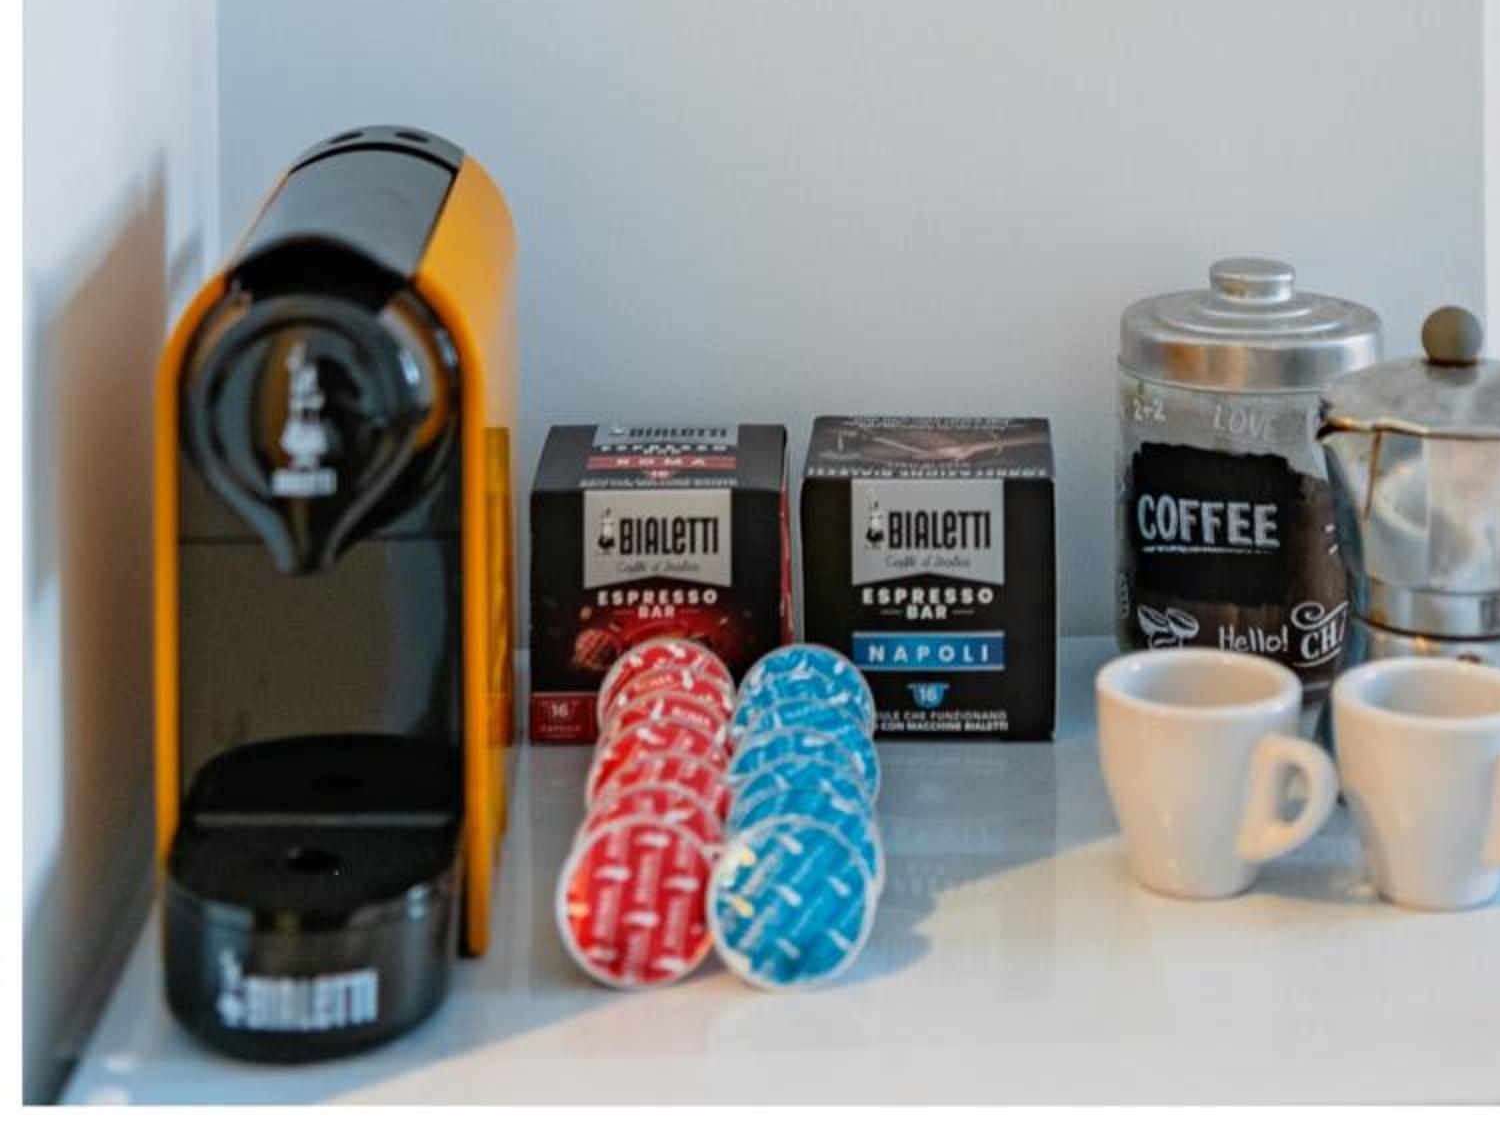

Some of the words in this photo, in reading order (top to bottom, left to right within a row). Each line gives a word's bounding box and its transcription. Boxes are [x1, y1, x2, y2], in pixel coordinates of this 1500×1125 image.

[1137, 493, 1281, 548] COFFEE
[597, 589, 719, 606] ESPRESSO
[862, 587, 994, 604] ESPRESSO
[638, 605, 676, 619] BAR
[906, 604, 948, 619] BAR
[1218, 625, 1289, 653] Hello!
[868, 643, 990, 663] NAPOLI
